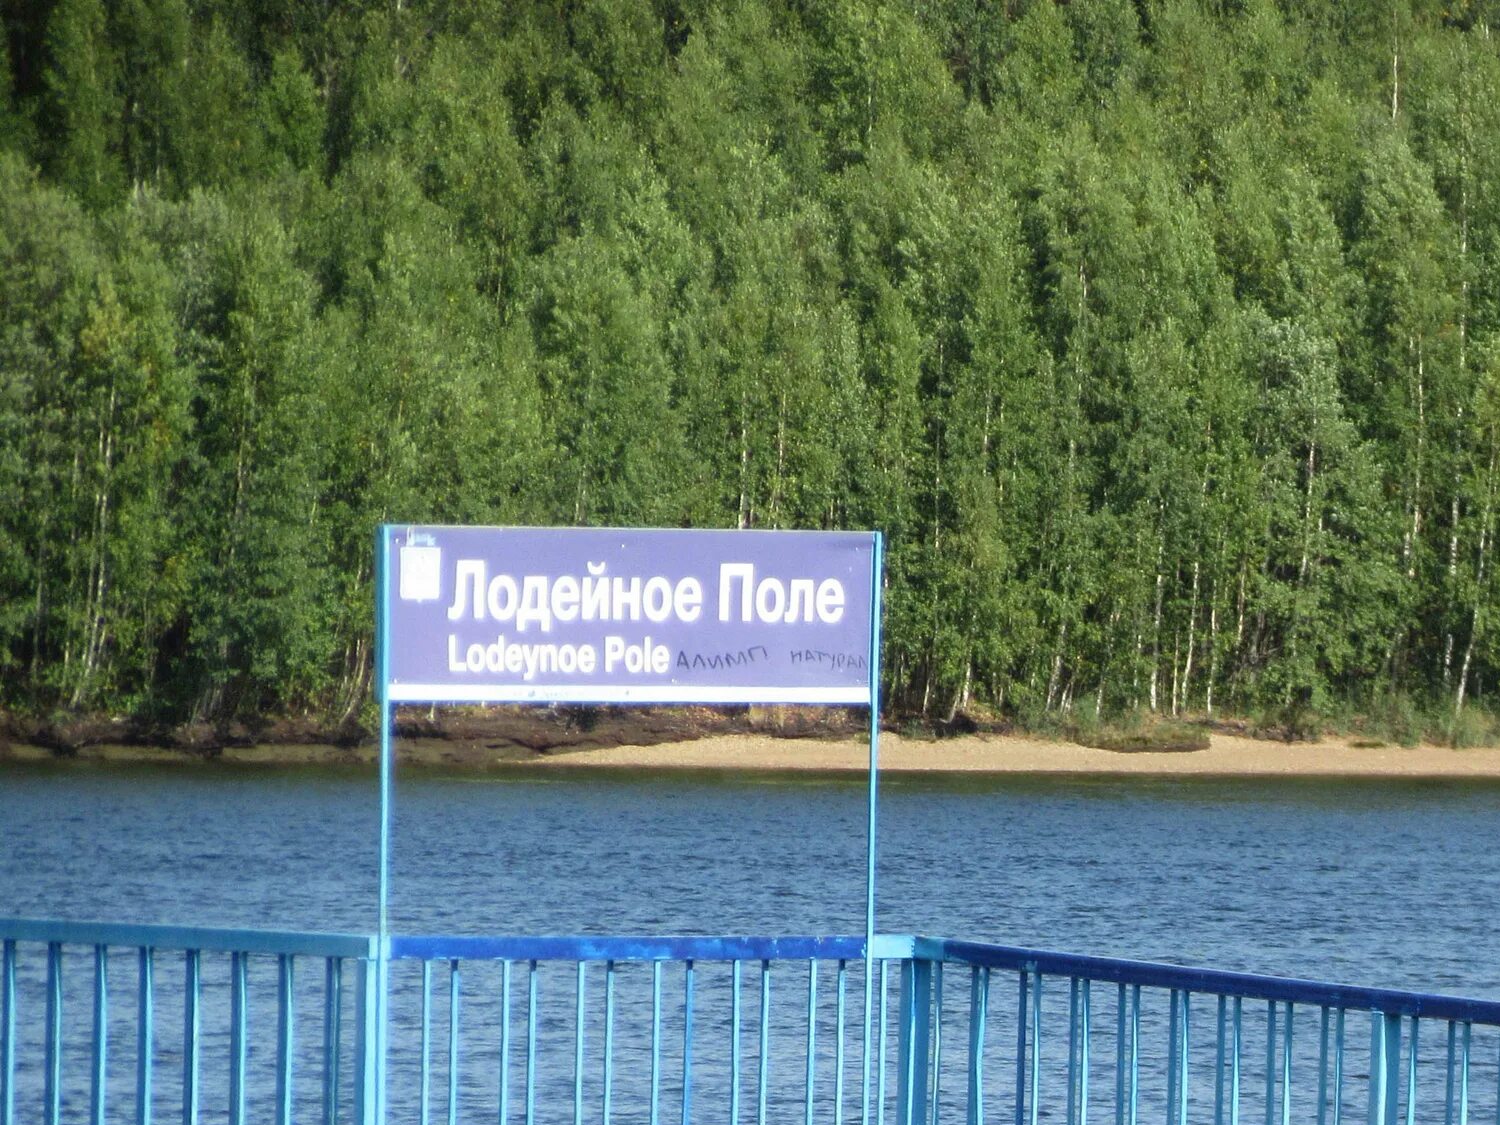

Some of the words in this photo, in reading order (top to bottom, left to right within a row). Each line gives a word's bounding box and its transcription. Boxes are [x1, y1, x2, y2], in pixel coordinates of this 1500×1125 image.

[447, 560, 702, 632] Лодейное
[718, 563, 845, 623] Поле
[448, 636, 596, 680] Lodeynoe
[605, 637, 670, 674] Pole
